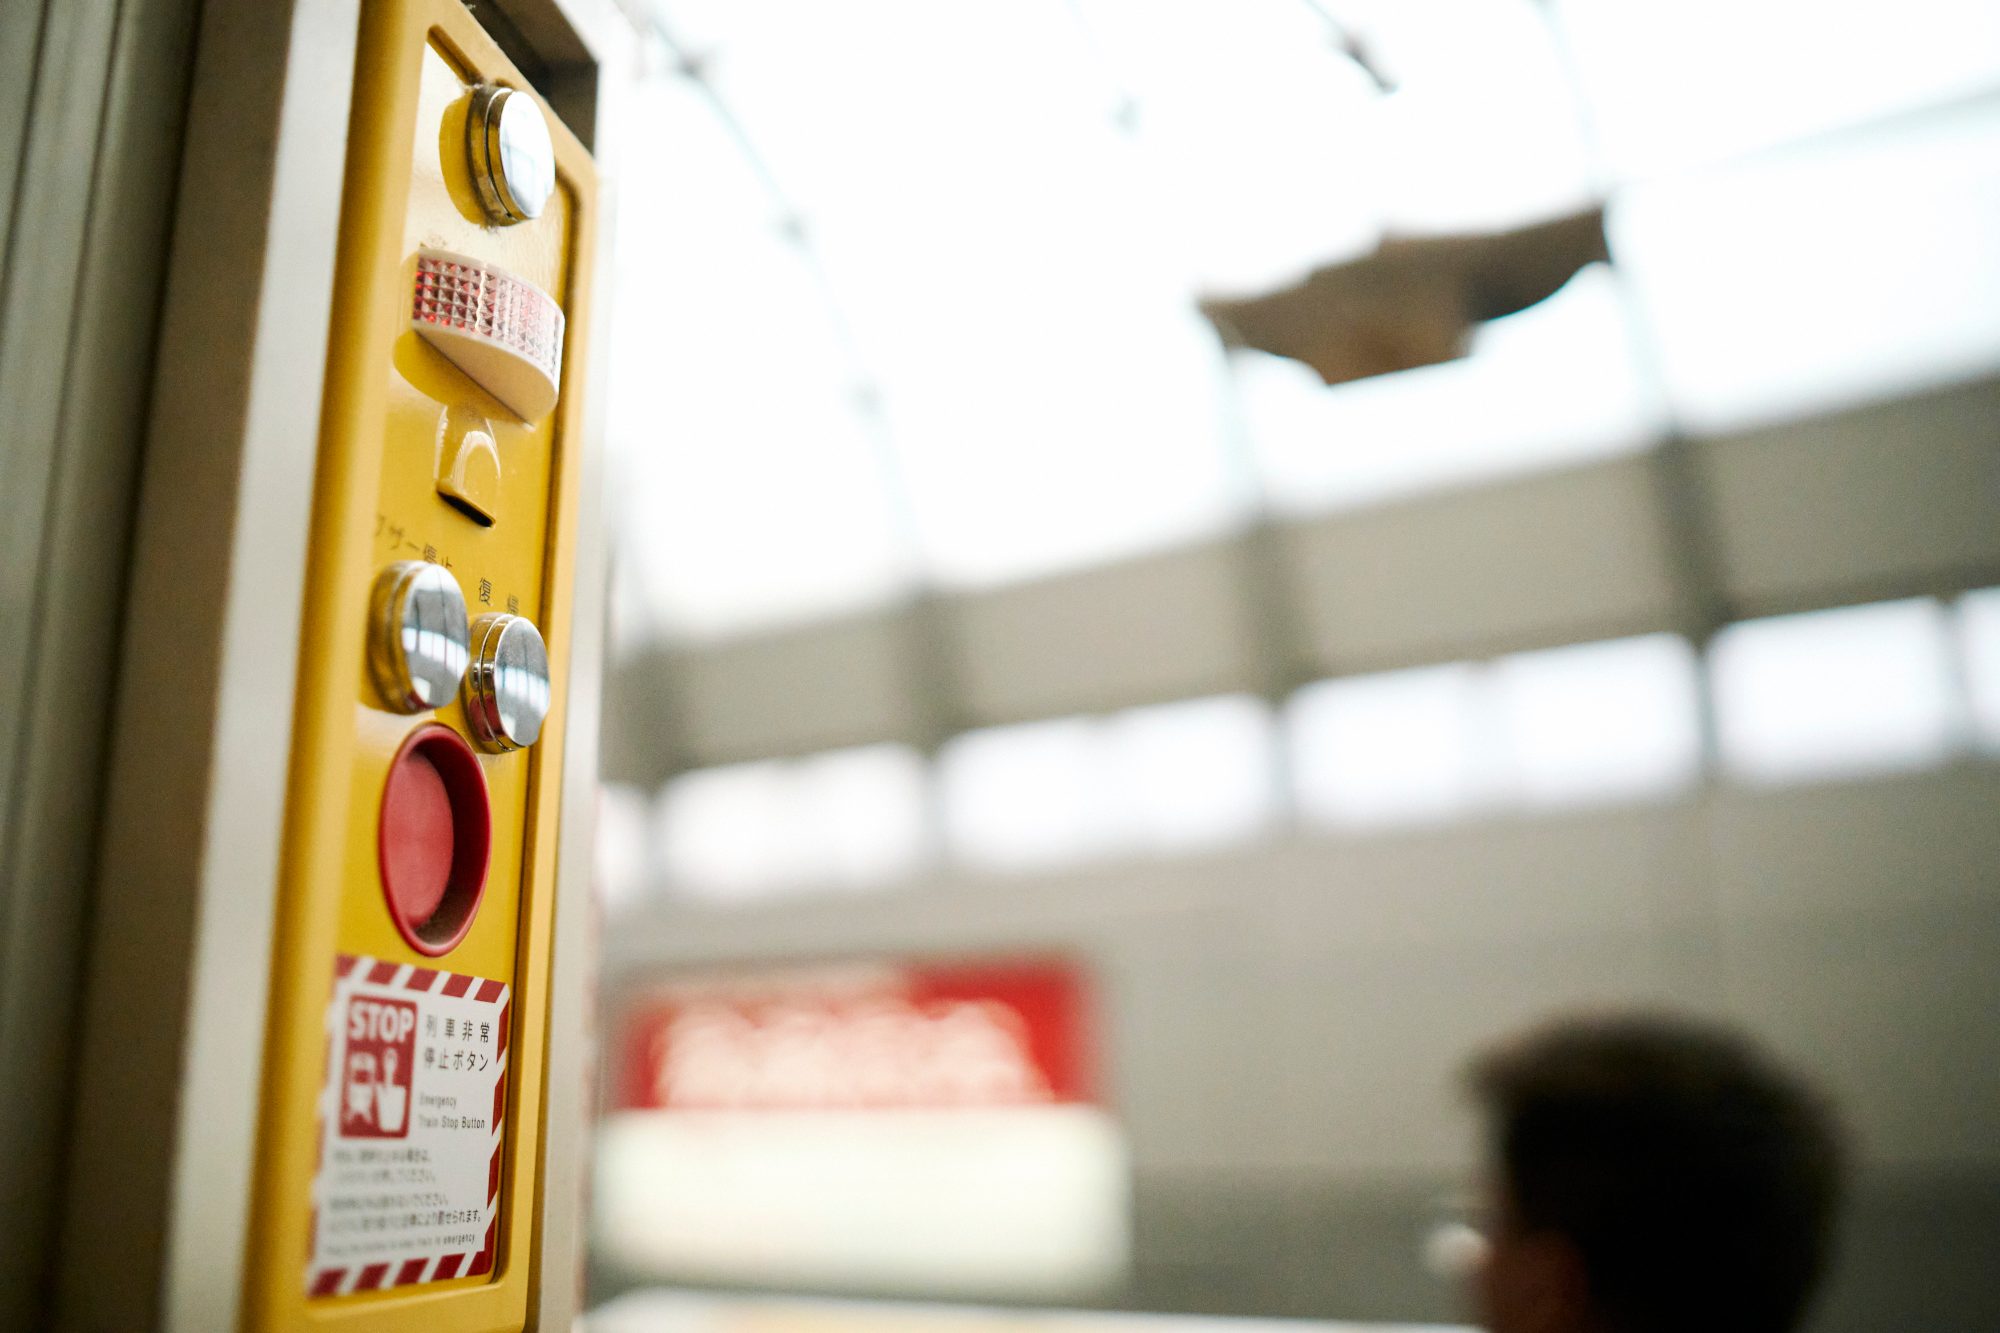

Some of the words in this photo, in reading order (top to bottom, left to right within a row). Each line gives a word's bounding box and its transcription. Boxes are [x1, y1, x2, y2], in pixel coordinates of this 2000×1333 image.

[348, 1001, 415, 1043] STOP
[424, 1047, 489, 1072] 停止ボタン
[419, 1092, 457, 1110] Emergency
[441, 1115, 459, 1130] Stop
[461, 1116, 485, 1129] Button
